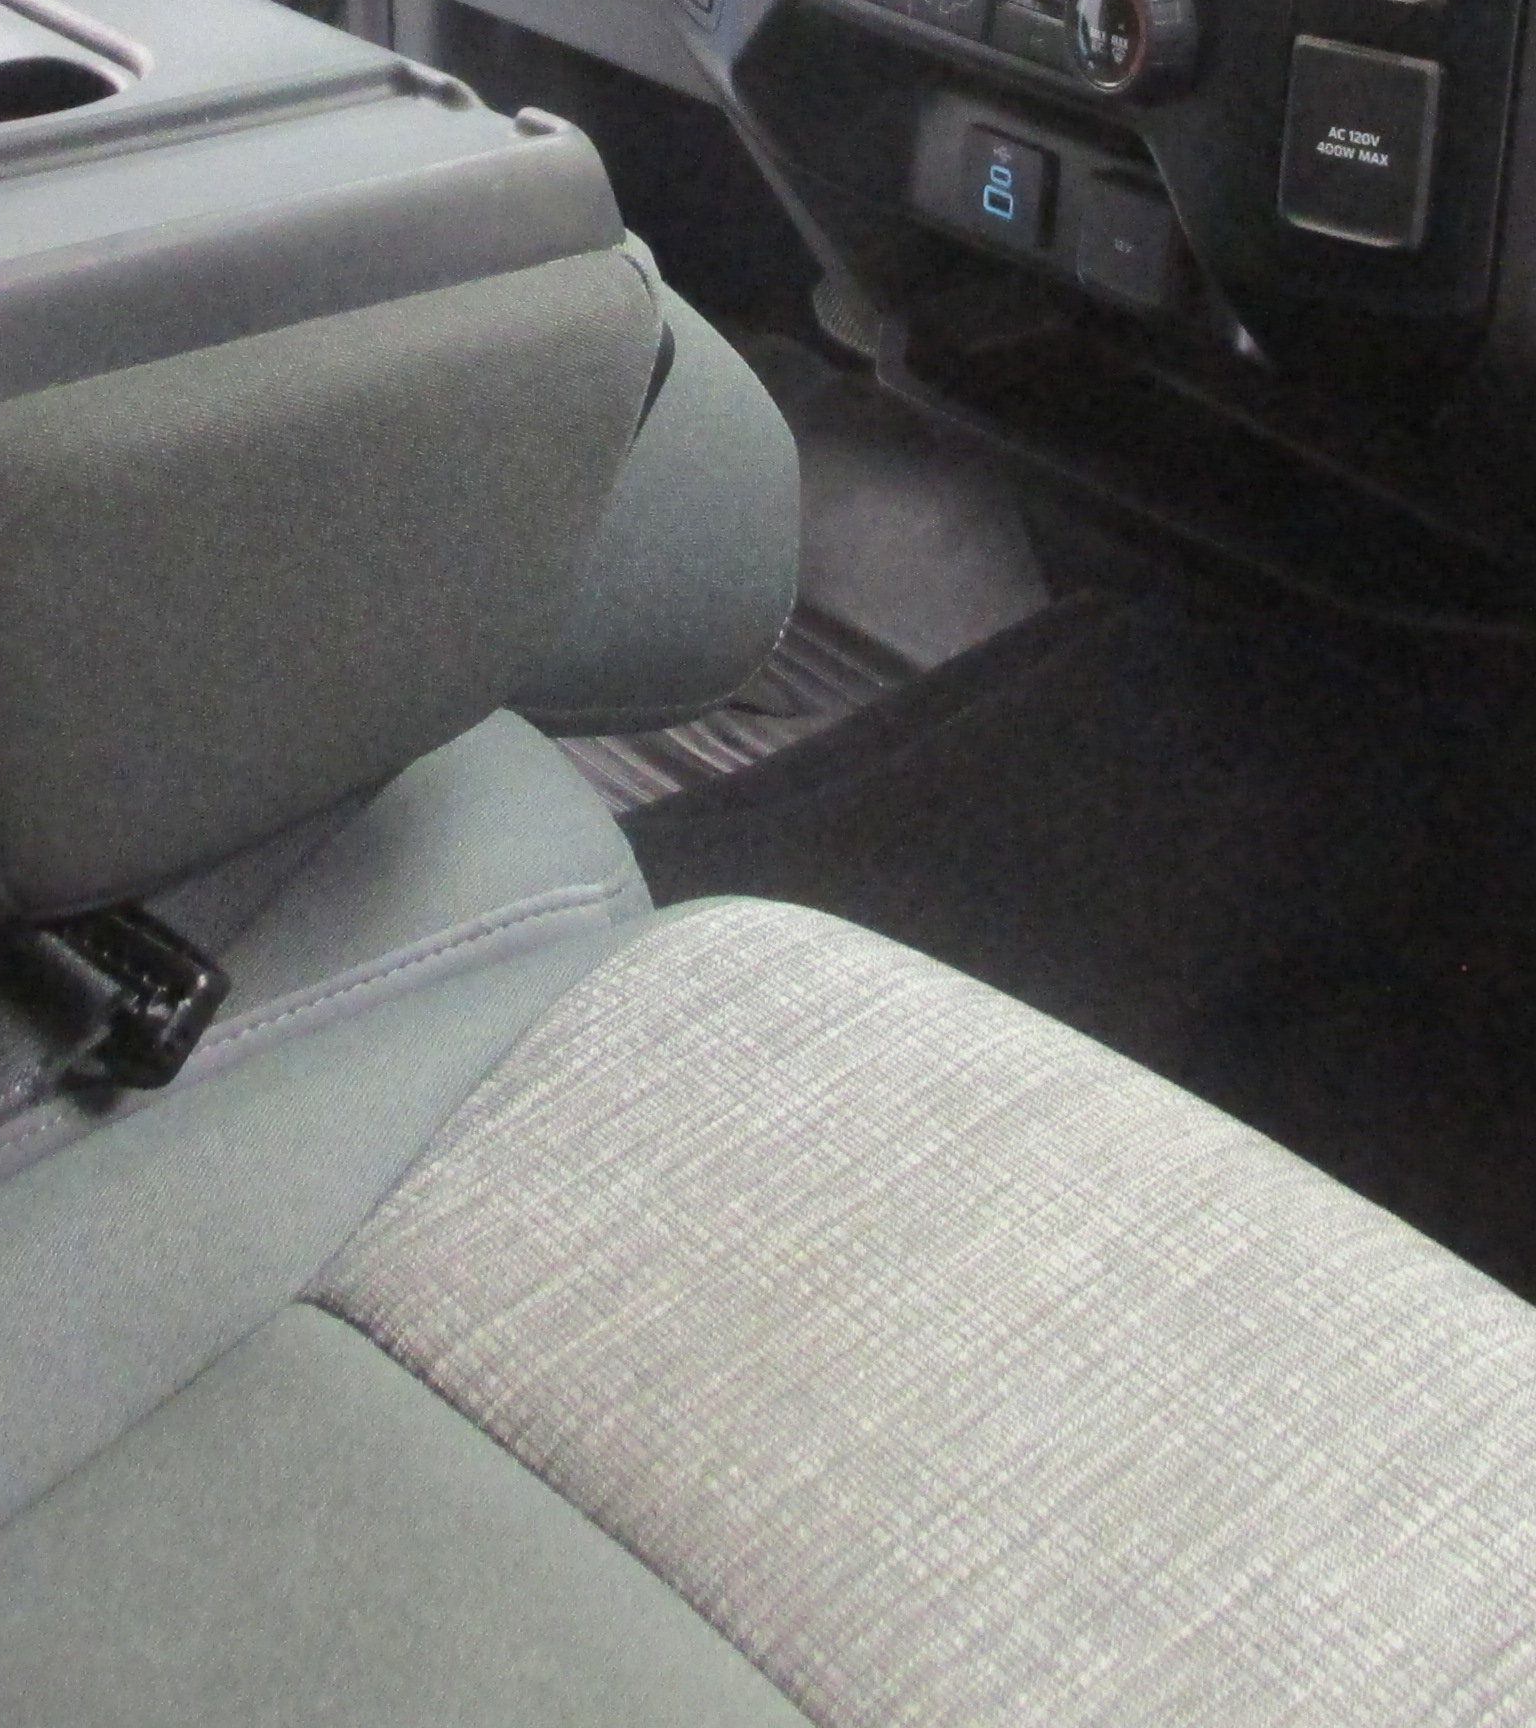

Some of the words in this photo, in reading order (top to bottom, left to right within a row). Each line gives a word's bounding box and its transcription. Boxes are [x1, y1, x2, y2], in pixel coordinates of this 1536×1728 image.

[1328, 126, 1346, 141] AC
[1348, 130, 1381, 147] 120V
[1316, 141, 1356, 159] 400W
[1358, 149, 1389, 167] MAX
